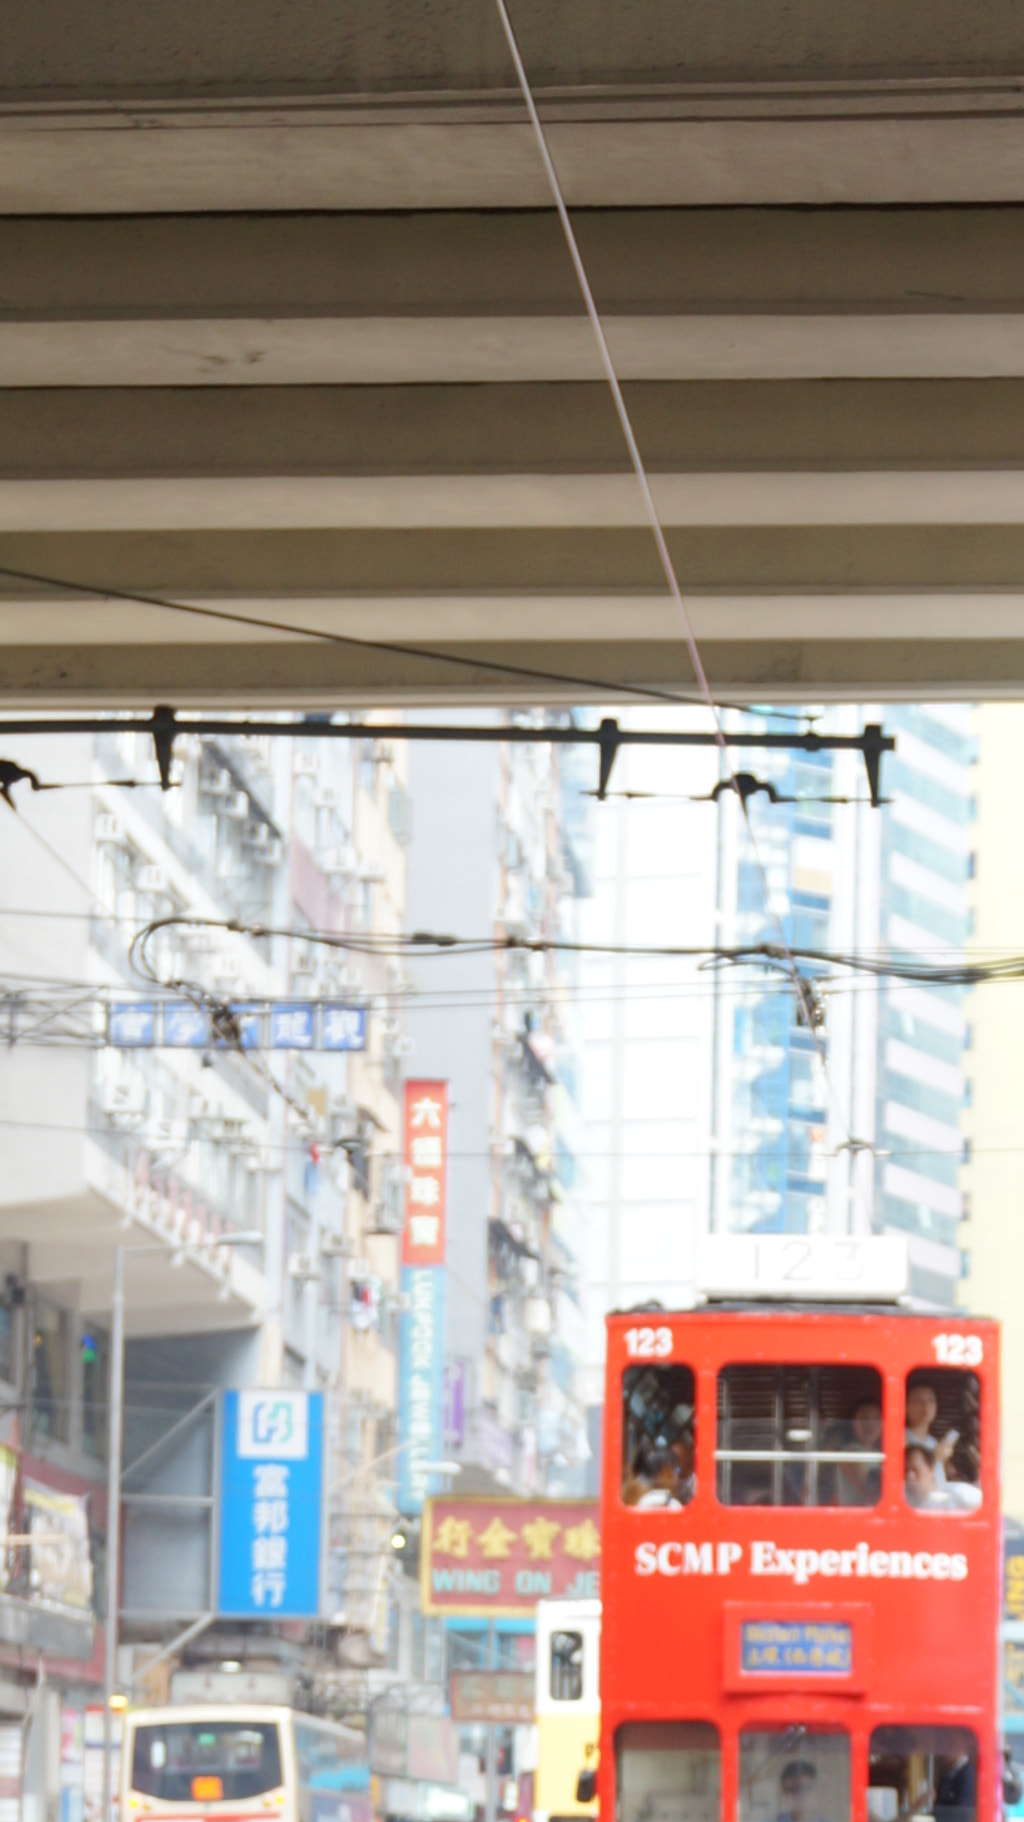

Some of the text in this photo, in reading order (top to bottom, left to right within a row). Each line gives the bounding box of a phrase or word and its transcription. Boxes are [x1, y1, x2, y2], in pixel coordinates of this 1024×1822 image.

[754, 1240, 864, 1281] 123
[625, 1327, 673, 1357] 123
[932, 1334, 983, 1366] 123
[635, 1541, 968, 1584] SCMP Experiences
[432, 1568, 499, 1594] WING
[515, 1570, 551, 1596] ON
